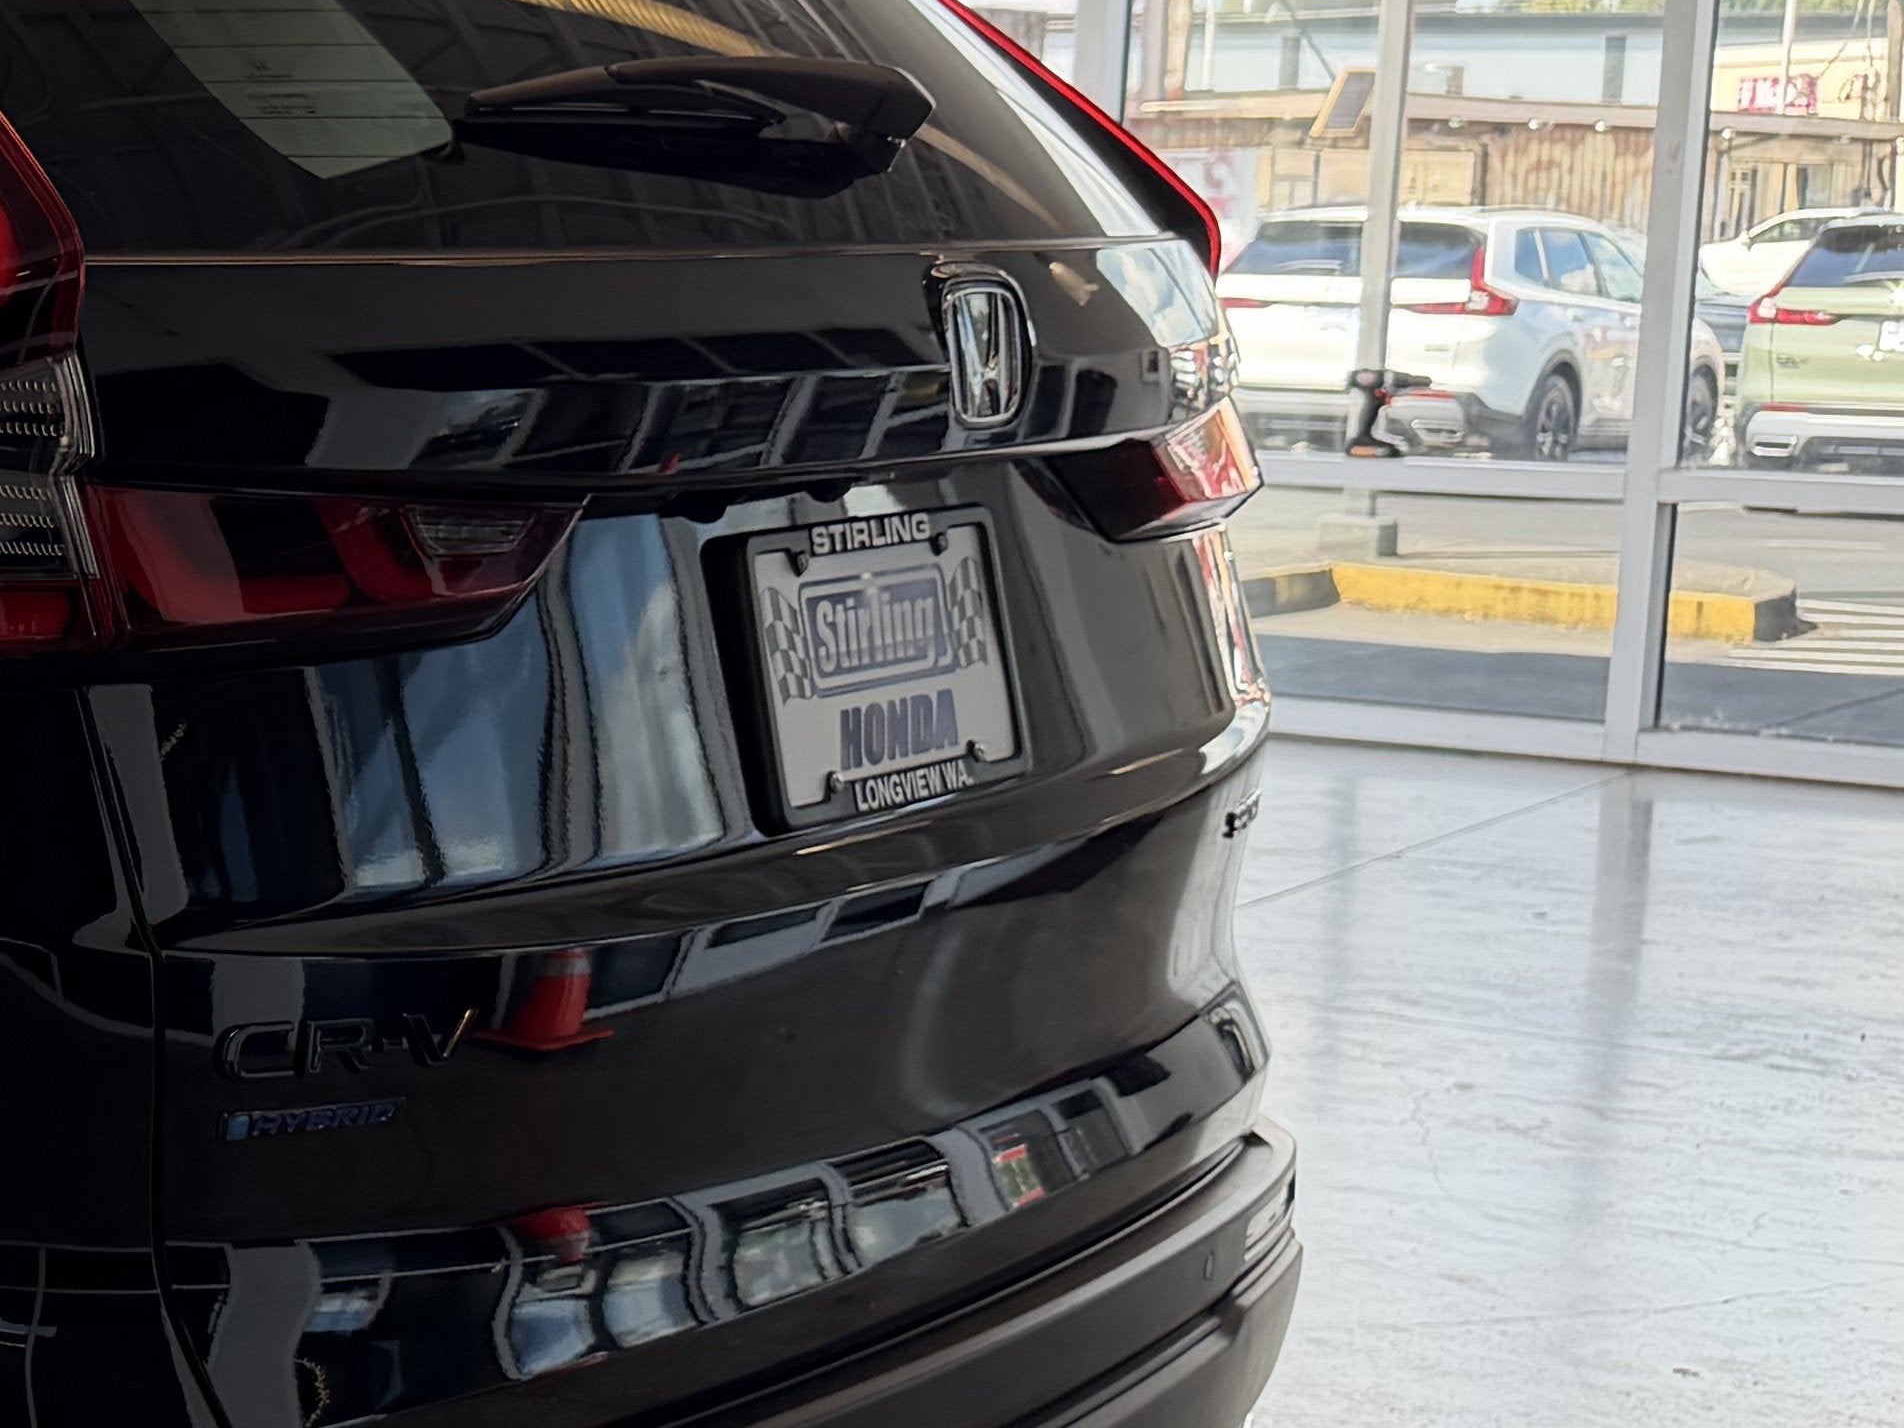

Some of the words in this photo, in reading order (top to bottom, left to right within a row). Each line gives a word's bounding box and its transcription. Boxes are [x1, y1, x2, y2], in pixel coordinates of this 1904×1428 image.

[810, 511, 932, 555] STIRLING
[815, 586, 937, 674] Stirling
[839, 688, 960, 772] HONDA
[854, 768, 942, 812] LONGVIEW
[213, 1007, 479, 1081] CR-V
[252, 1101, 398, 1137] HYBRID
